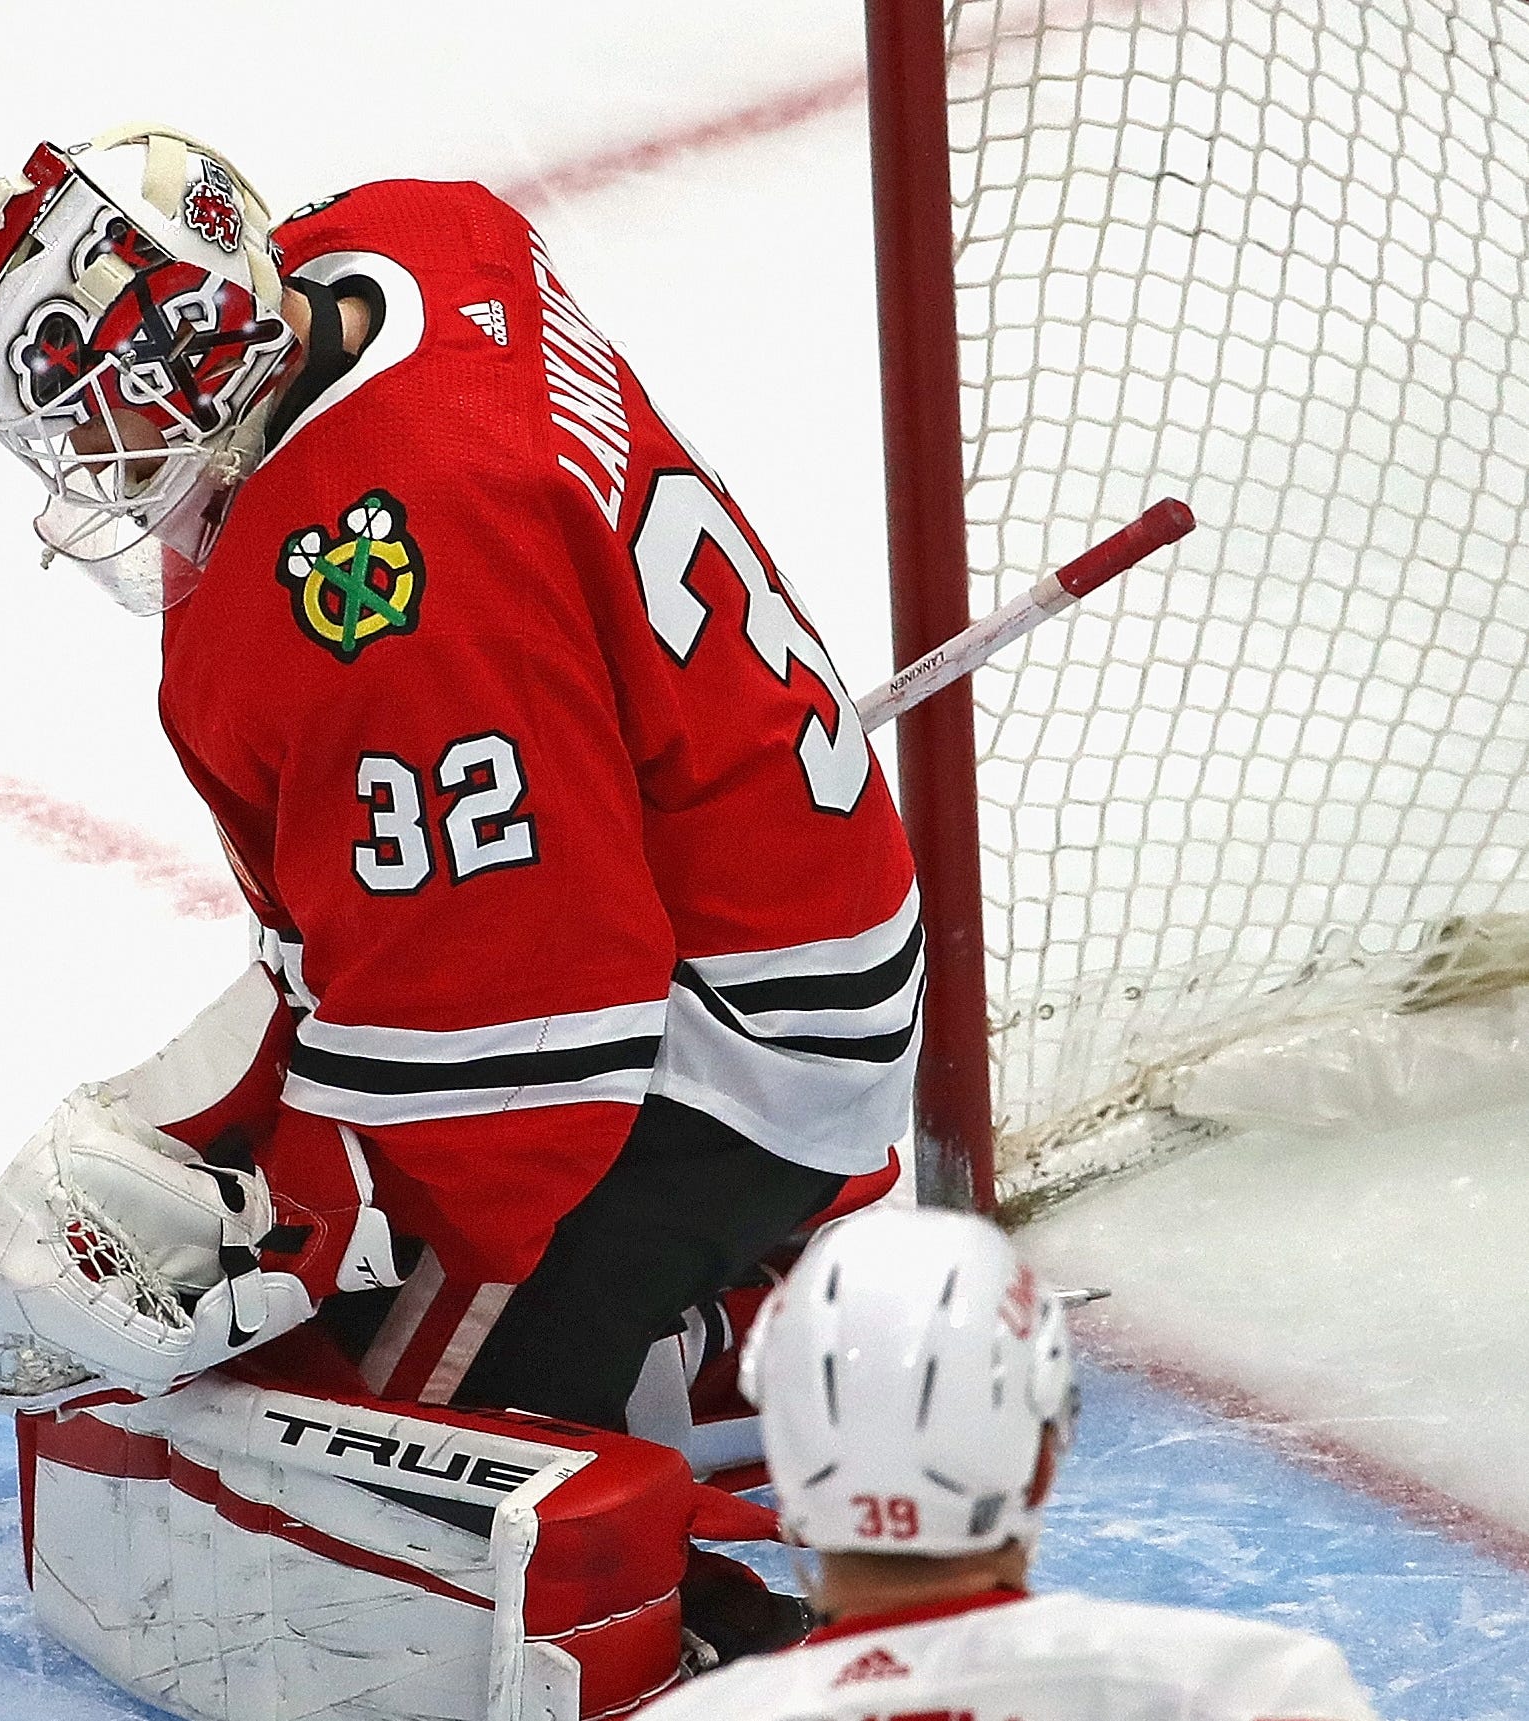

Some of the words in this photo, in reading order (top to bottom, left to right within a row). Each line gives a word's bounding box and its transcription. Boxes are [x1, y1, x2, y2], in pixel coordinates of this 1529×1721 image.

[489, 299, 508, 347] adidas
[527, 229, 631, 533] LANKINE
[628, 440, 872, 820] 3
[889, 651, 945, 695] LANKINEN
[350, 729, 541, 893] 32
[264, 1409, 541, 1494] TRUE
[849, 1494, 920, 1541] 39
